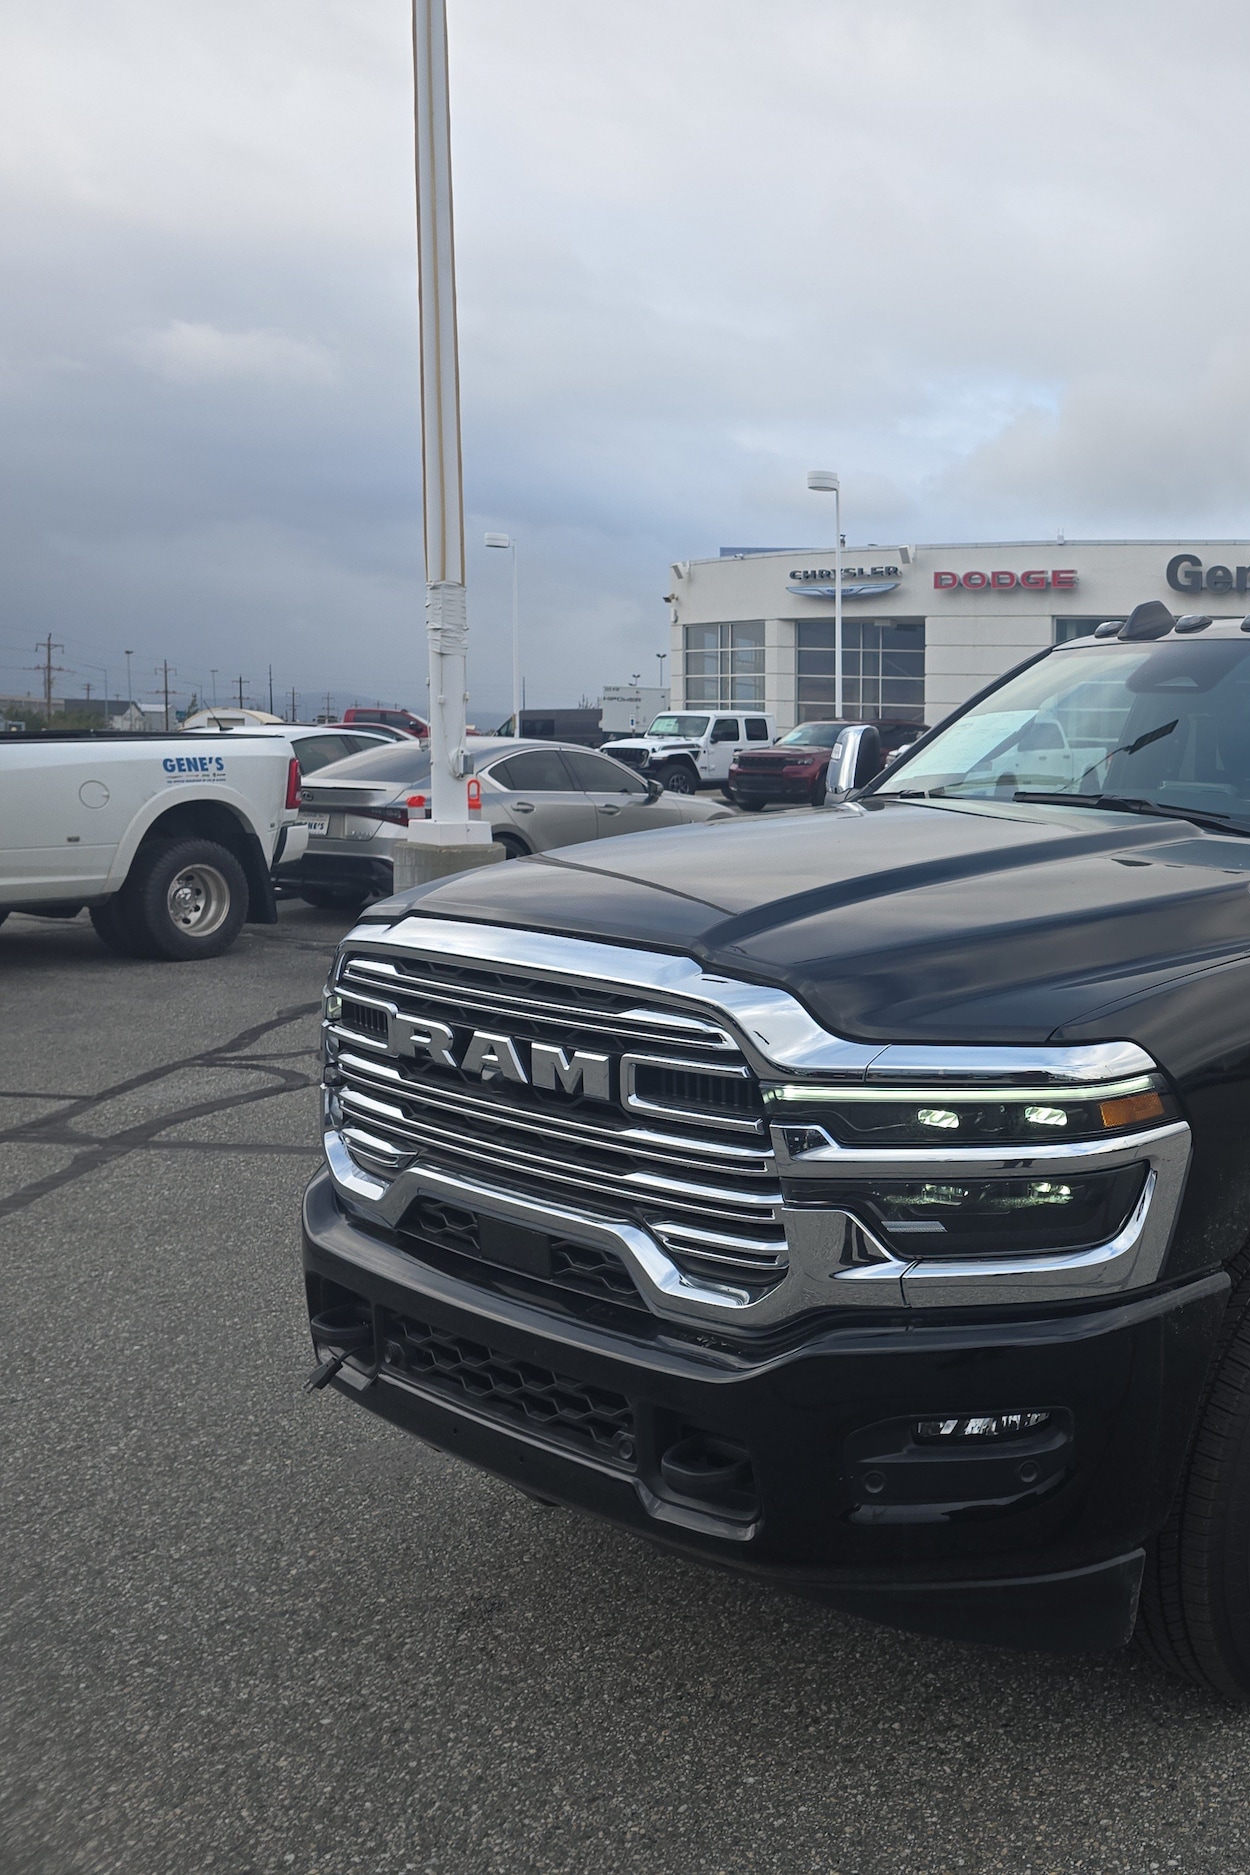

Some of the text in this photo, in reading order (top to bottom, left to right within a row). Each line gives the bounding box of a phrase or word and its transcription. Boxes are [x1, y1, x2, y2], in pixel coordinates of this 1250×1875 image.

[933, 569, 1078, 590] DODGE
[163, 756, 225, 773] GENE'S
[391, 1013, 610, 1101] RAM
